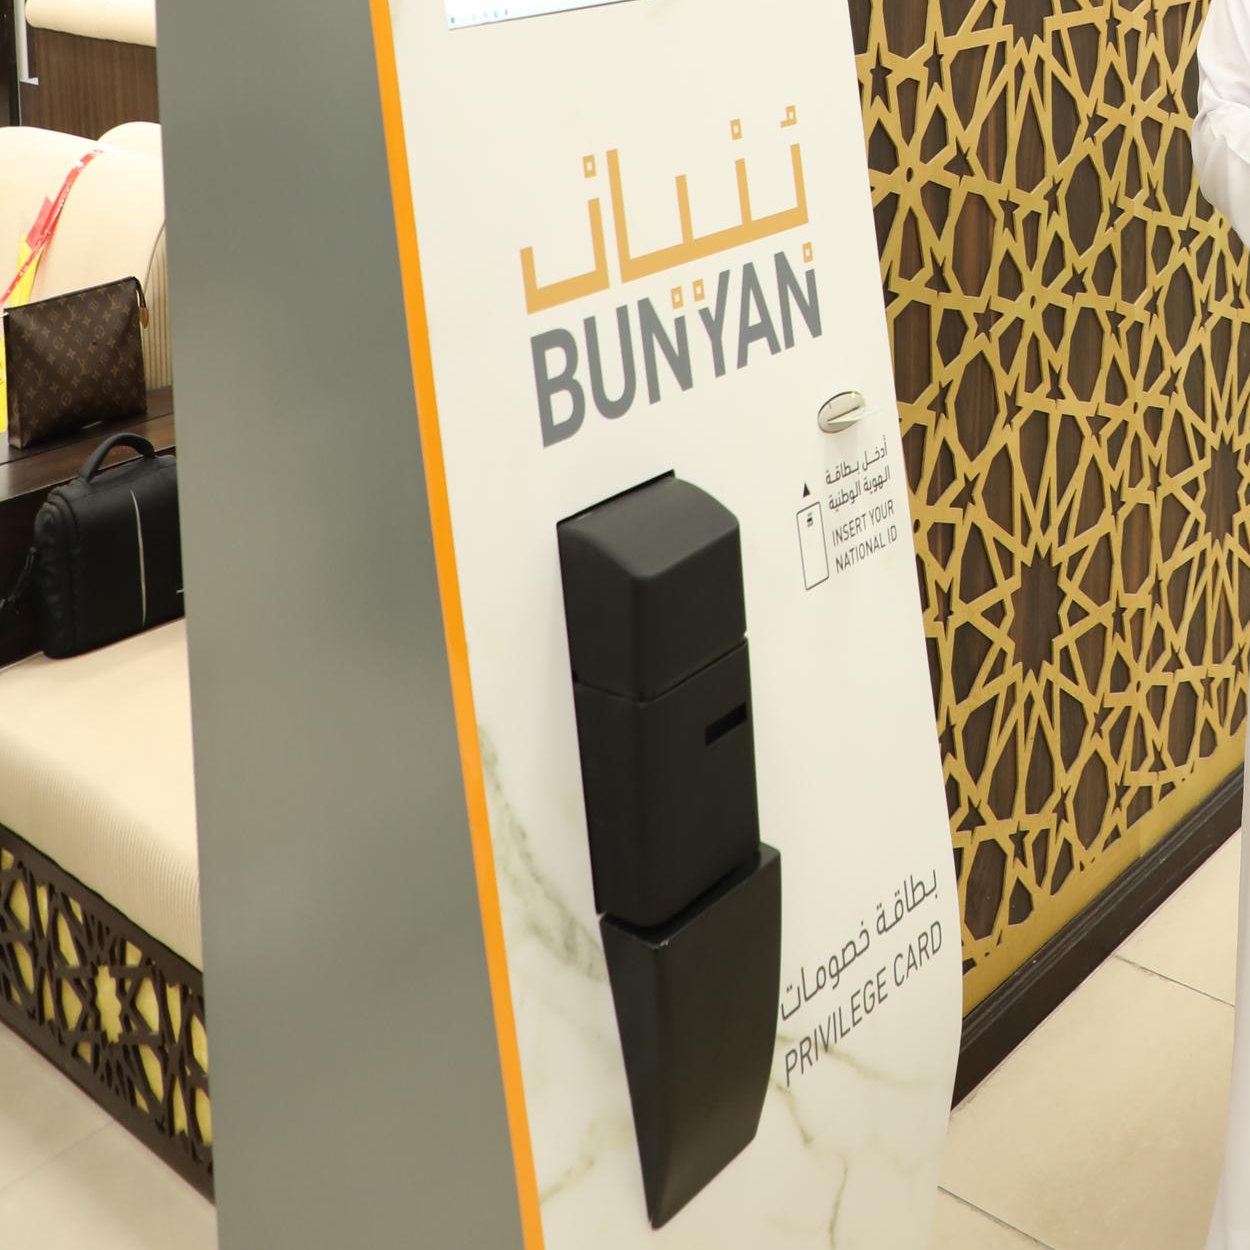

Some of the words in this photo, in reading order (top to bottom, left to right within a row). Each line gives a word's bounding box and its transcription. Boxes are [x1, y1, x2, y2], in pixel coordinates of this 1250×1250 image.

[530, 250, 823, 449] BUNYAN
[825, 460, 860, 485] بطاقة
[862, 434, 888, 471] أدخل
[829, 480, 861, 512] الوطنية
[863, 464, 891, 495] الهوية
[832, 512, 867, 547] INSERT
[868, 498, 895, 526] YOUR
[835, 531, 886, 574] NATIONAL
[887, 524, 898, 544] ID
[876, 869, 938, 936] بطاقة
[781, 920, 870, 1021] خصومات
[784, 966, 888, 1087] PRIVILEGE
[893, 920, 943, 987] CARD
